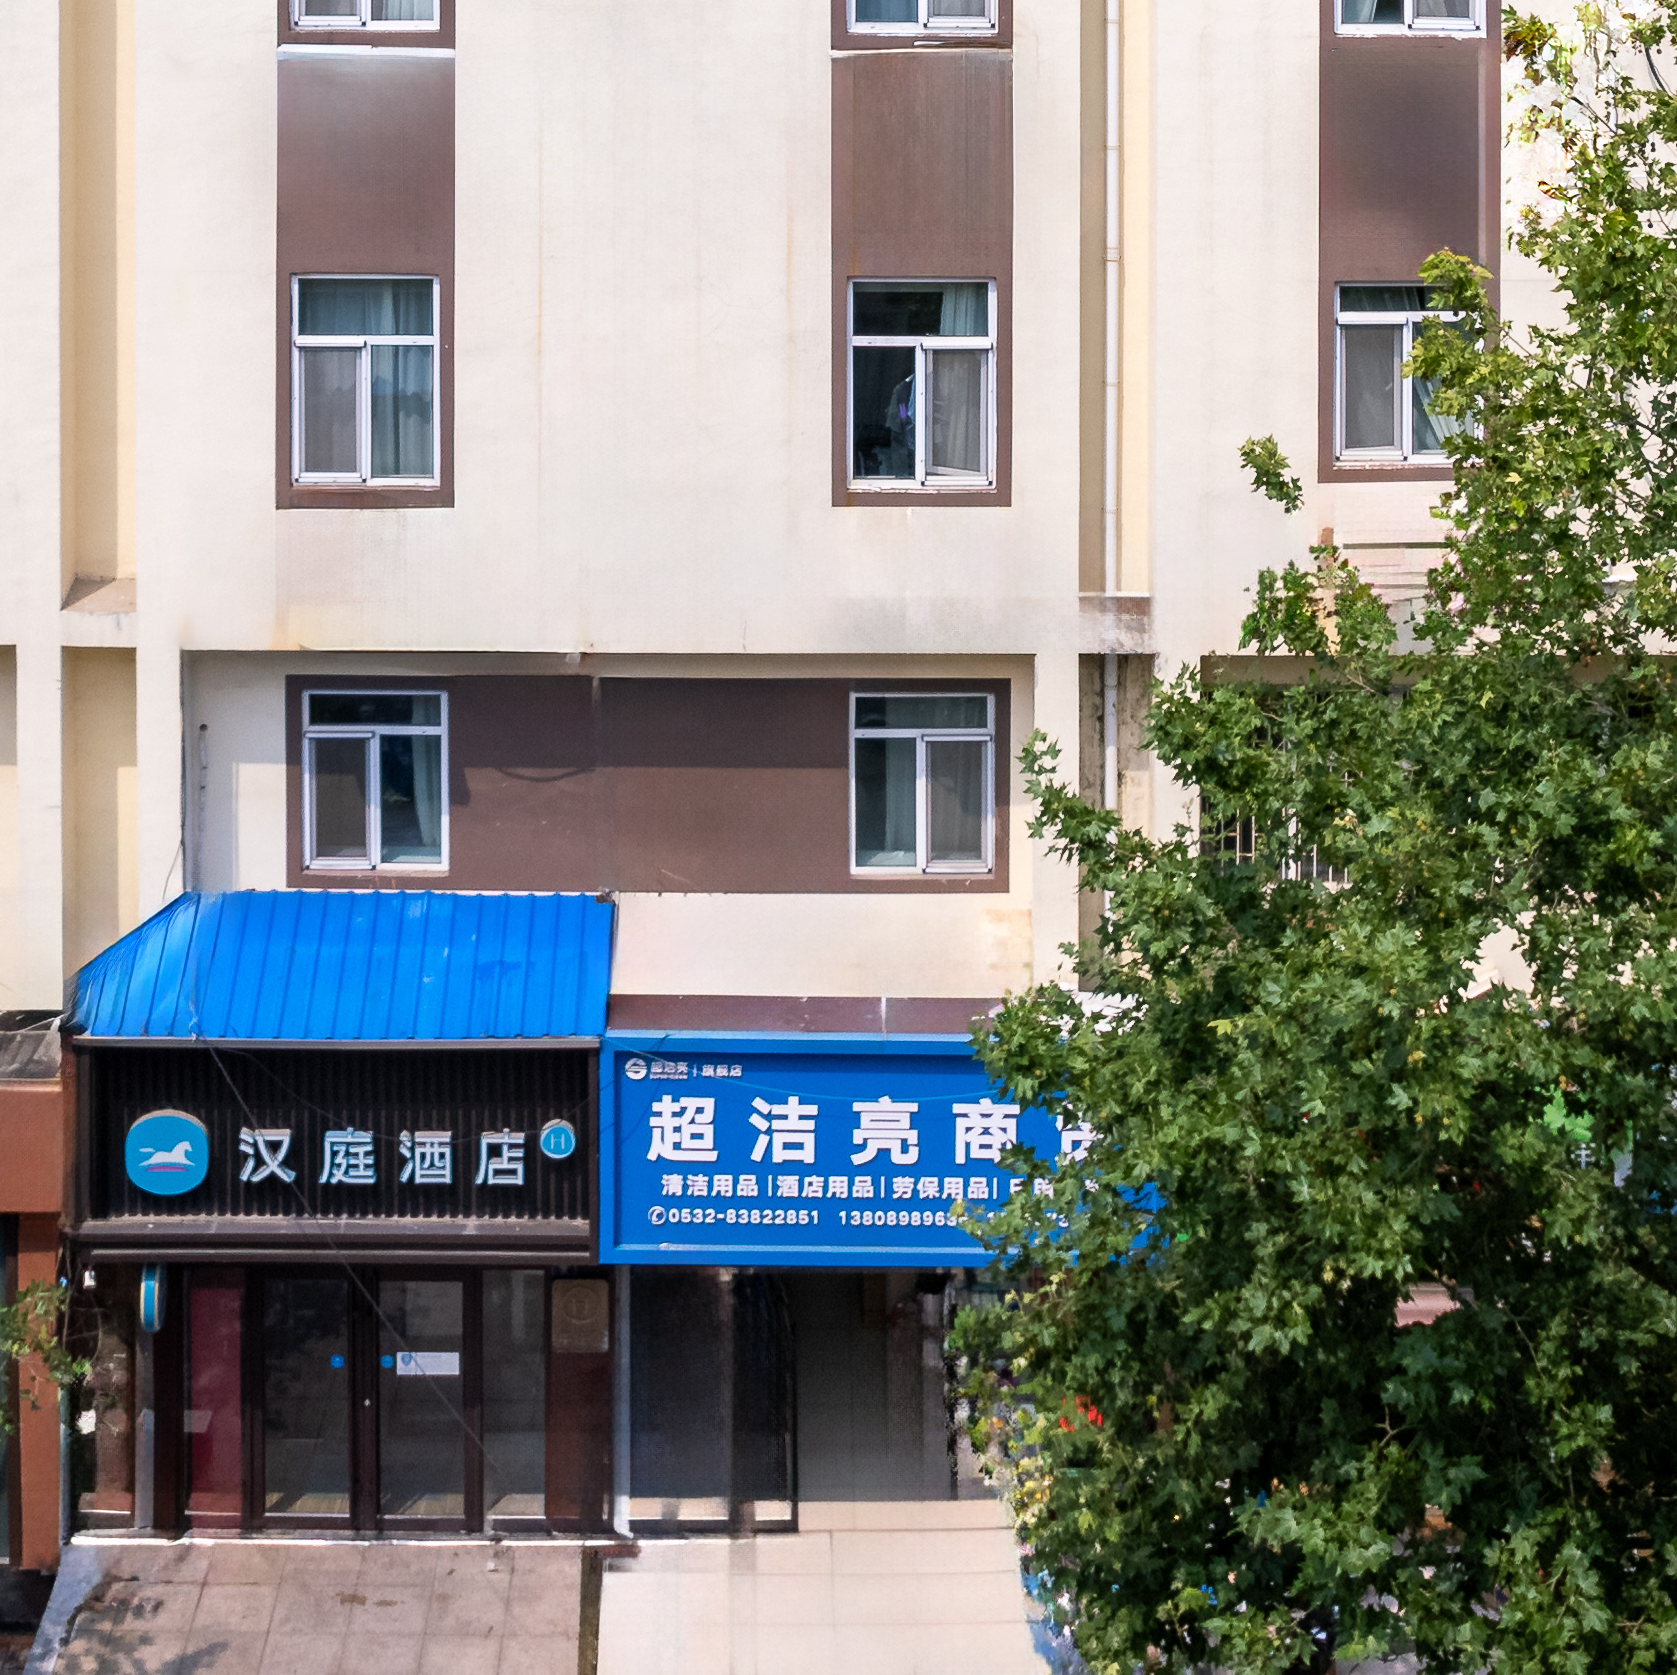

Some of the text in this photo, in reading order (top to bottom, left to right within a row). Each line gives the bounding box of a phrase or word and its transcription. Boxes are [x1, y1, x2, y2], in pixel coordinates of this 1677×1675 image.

[238, 1126, 525, 1185] 汉庭酒店
[661, 1174, 758, 1197] 清洁用品
[776, 1175, 874, 1199] 酒店用品
[668, 1208, 819, 1225] 0532-83822851
